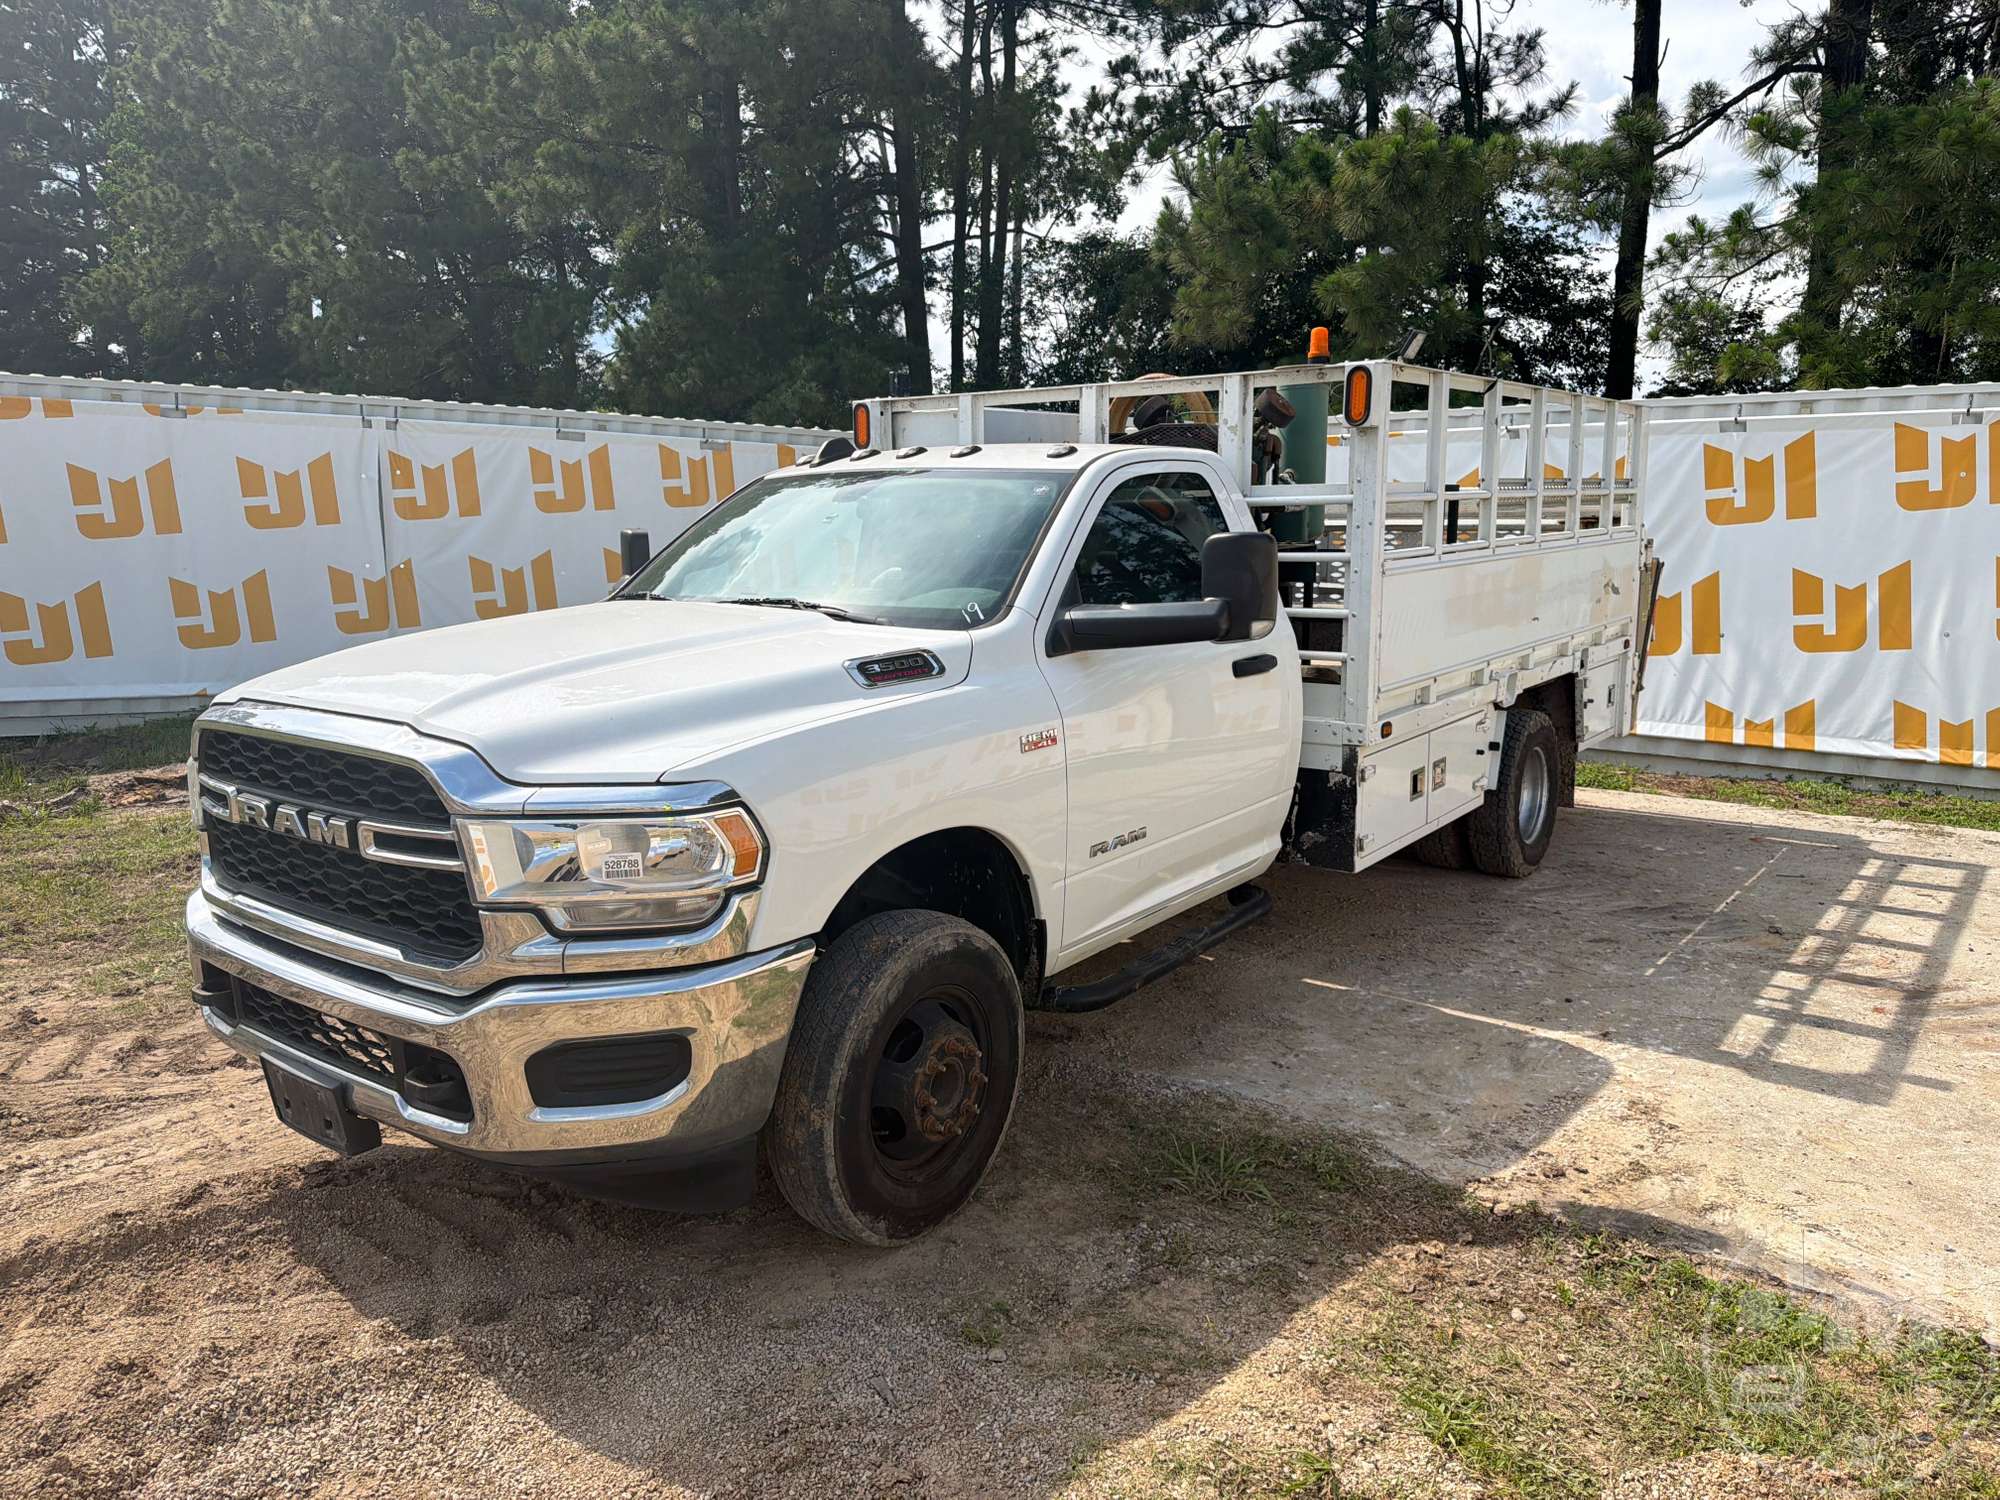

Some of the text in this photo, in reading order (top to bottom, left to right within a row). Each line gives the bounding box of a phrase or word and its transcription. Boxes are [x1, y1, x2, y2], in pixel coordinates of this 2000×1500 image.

[961, 602, 985, 625] 19
[864, 657, 924, 674] 3500
[1020, 728, 1058, 744] HEMI
[237, 793, 350, 849] RAM
[1089, 826, 1147, 858] RAM
[604, 858, 640, 870] 528788
